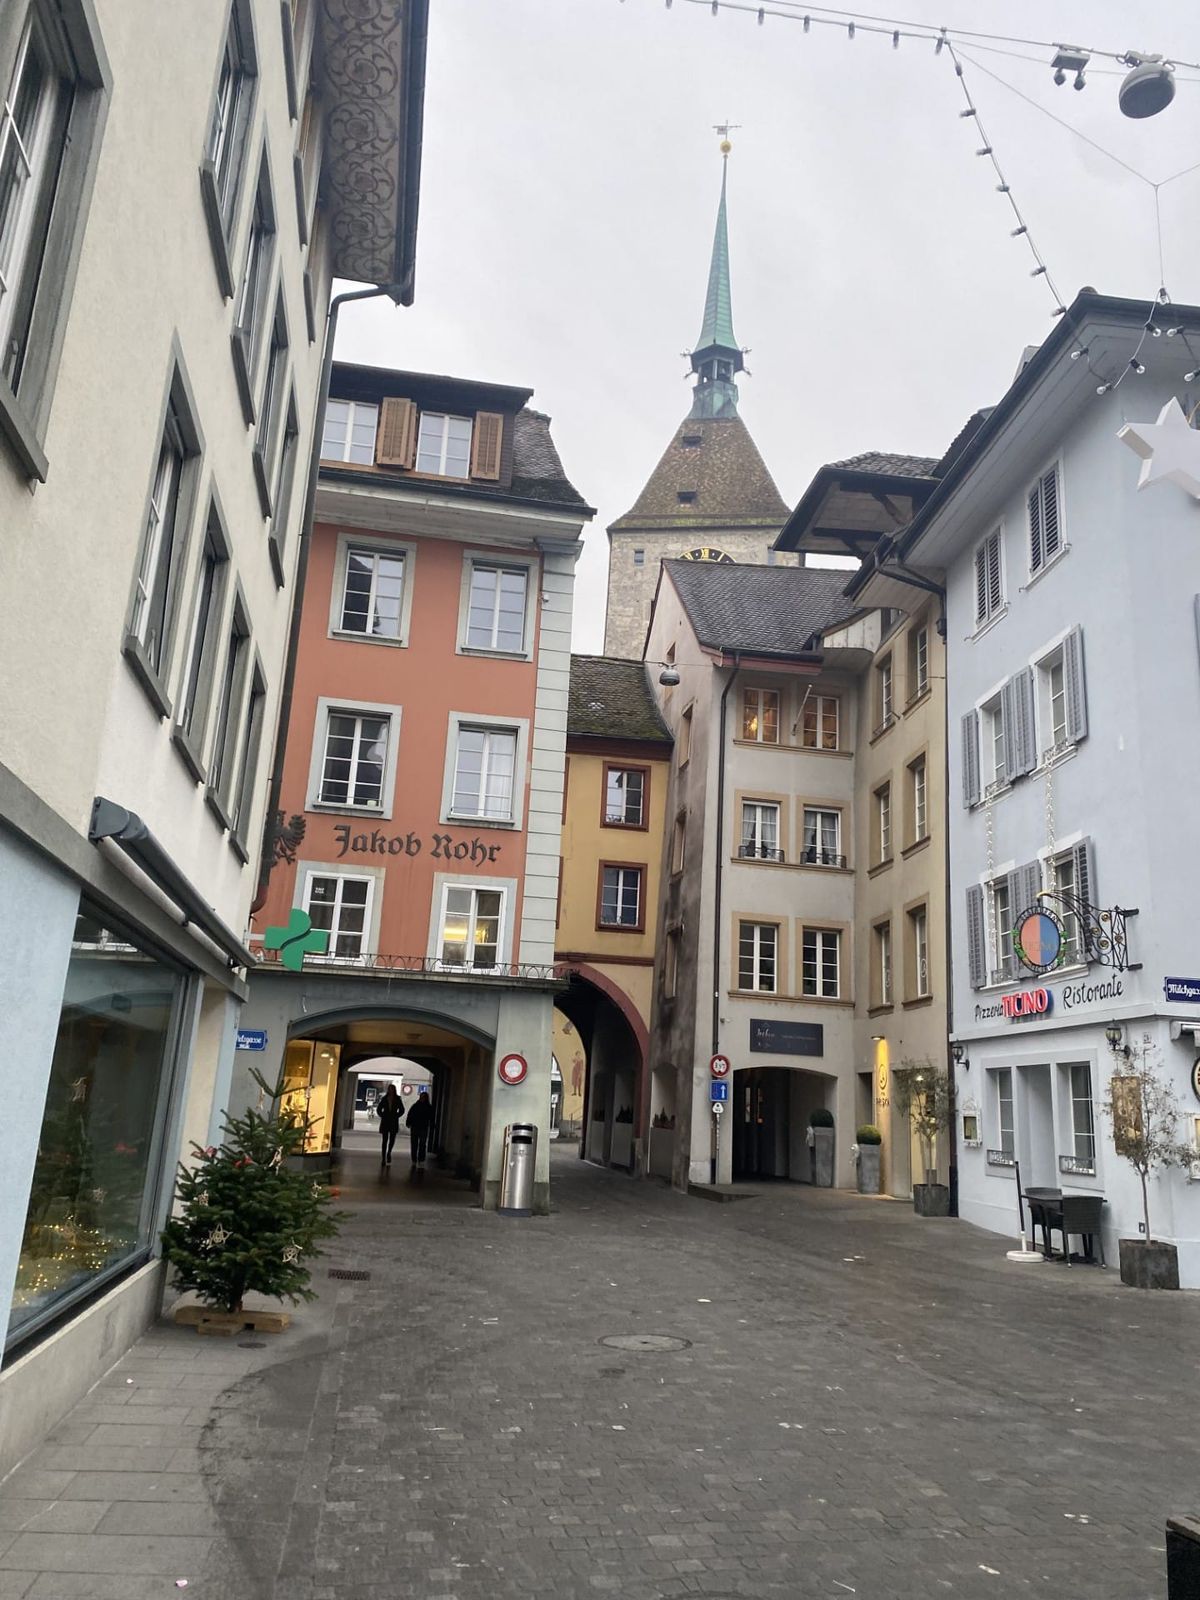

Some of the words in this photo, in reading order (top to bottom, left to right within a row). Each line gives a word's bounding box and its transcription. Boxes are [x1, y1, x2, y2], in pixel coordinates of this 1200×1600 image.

[333, 824, 422, 858] Jakob
[431, 833, 502, 867] Rohr
[975, 1004, 1004, 1022] Pizzeria
[1002, 987, 1050, 1018] TICINO
[1063, 973, 1124, 1010] Ristorante
